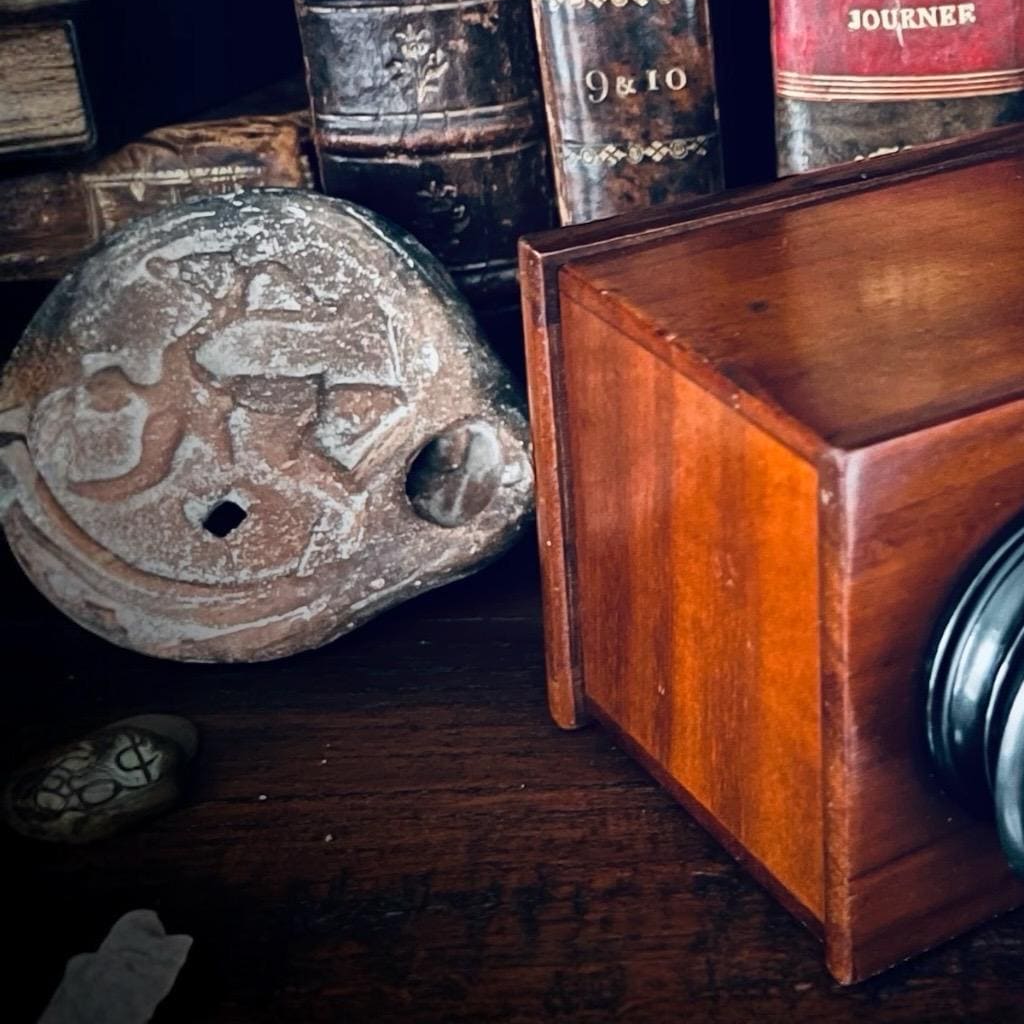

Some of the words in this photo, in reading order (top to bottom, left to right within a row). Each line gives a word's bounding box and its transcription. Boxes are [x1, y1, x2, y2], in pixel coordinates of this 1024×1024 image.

[848, 3, 976, 31] JOURNEE
[585, 69, 609, 104] 9
[615, 75, 637, 97] &
[646, 67, 687, 91] 10
